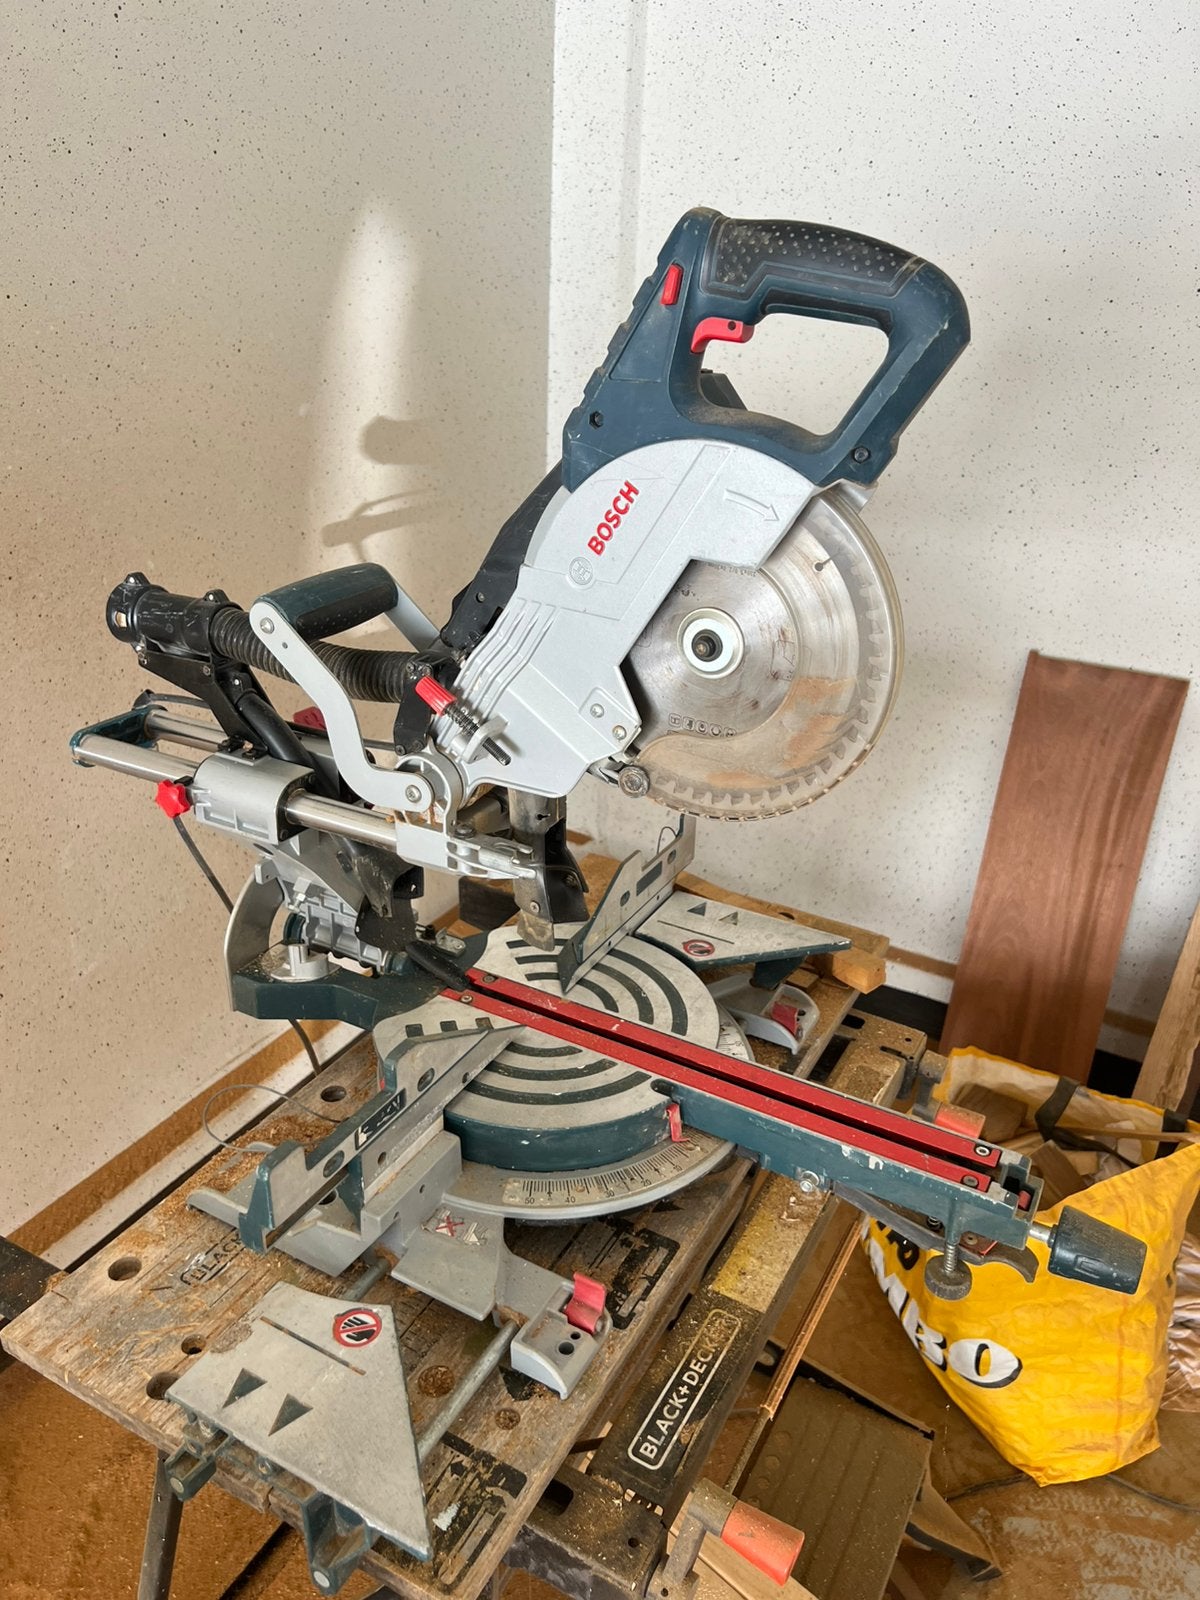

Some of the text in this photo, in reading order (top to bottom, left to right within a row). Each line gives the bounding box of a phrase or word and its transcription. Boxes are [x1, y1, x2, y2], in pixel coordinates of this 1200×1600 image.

[587, 480, 640, 556] BOSCH
[524, 1196, 536, 1205] 50
[565, 1195, 577, 1204] 40
[604, 1189, 616, 1199] 30
[641, 1178, 653, 1187] 20
[639, 1327, 728, 1460] BLACK+DECK
